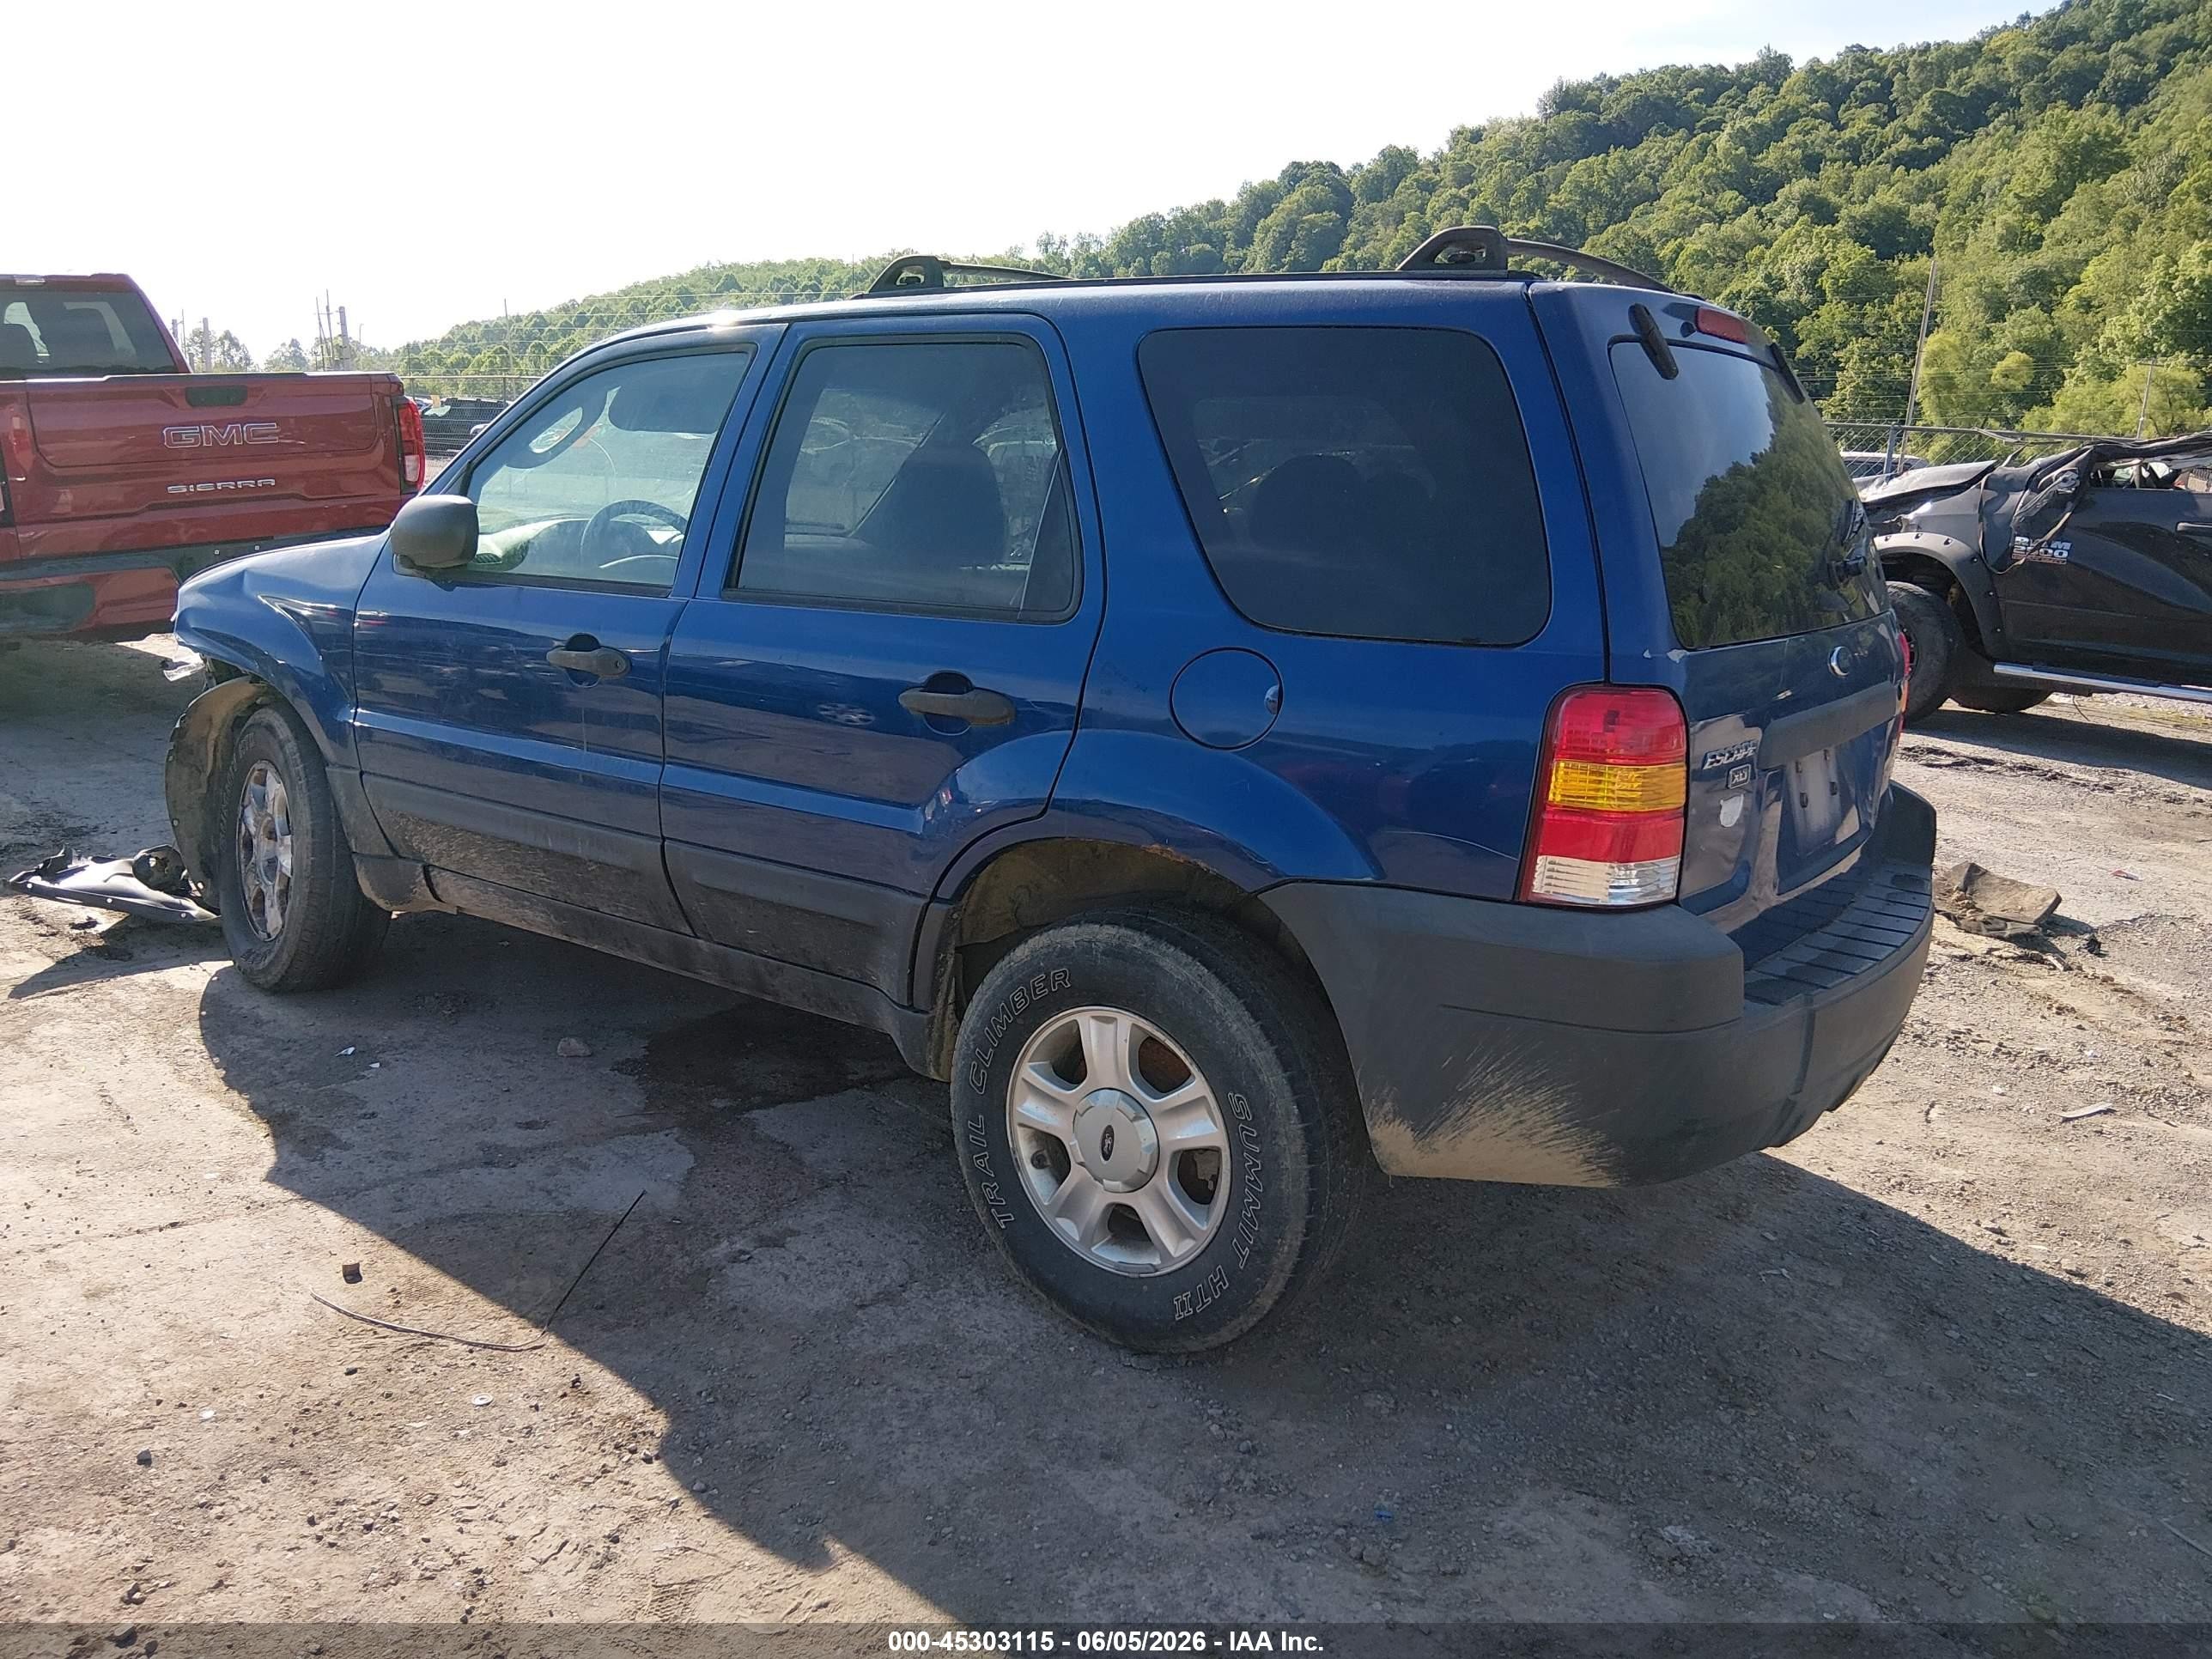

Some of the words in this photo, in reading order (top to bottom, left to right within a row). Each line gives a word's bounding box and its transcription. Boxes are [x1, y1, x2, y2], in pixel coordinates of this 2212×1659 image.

[163, 422, 279, 448] GMC
[167, 478, 276, 494] SIERRA
[1703, 740, 1757, 769] ESCAPE
[969, 968, 1072, 1095] CLIMBER
[968, 1115, 1015, 1230] TRAIL
[1228, 1092, 1263, 1269] SUMMIT
